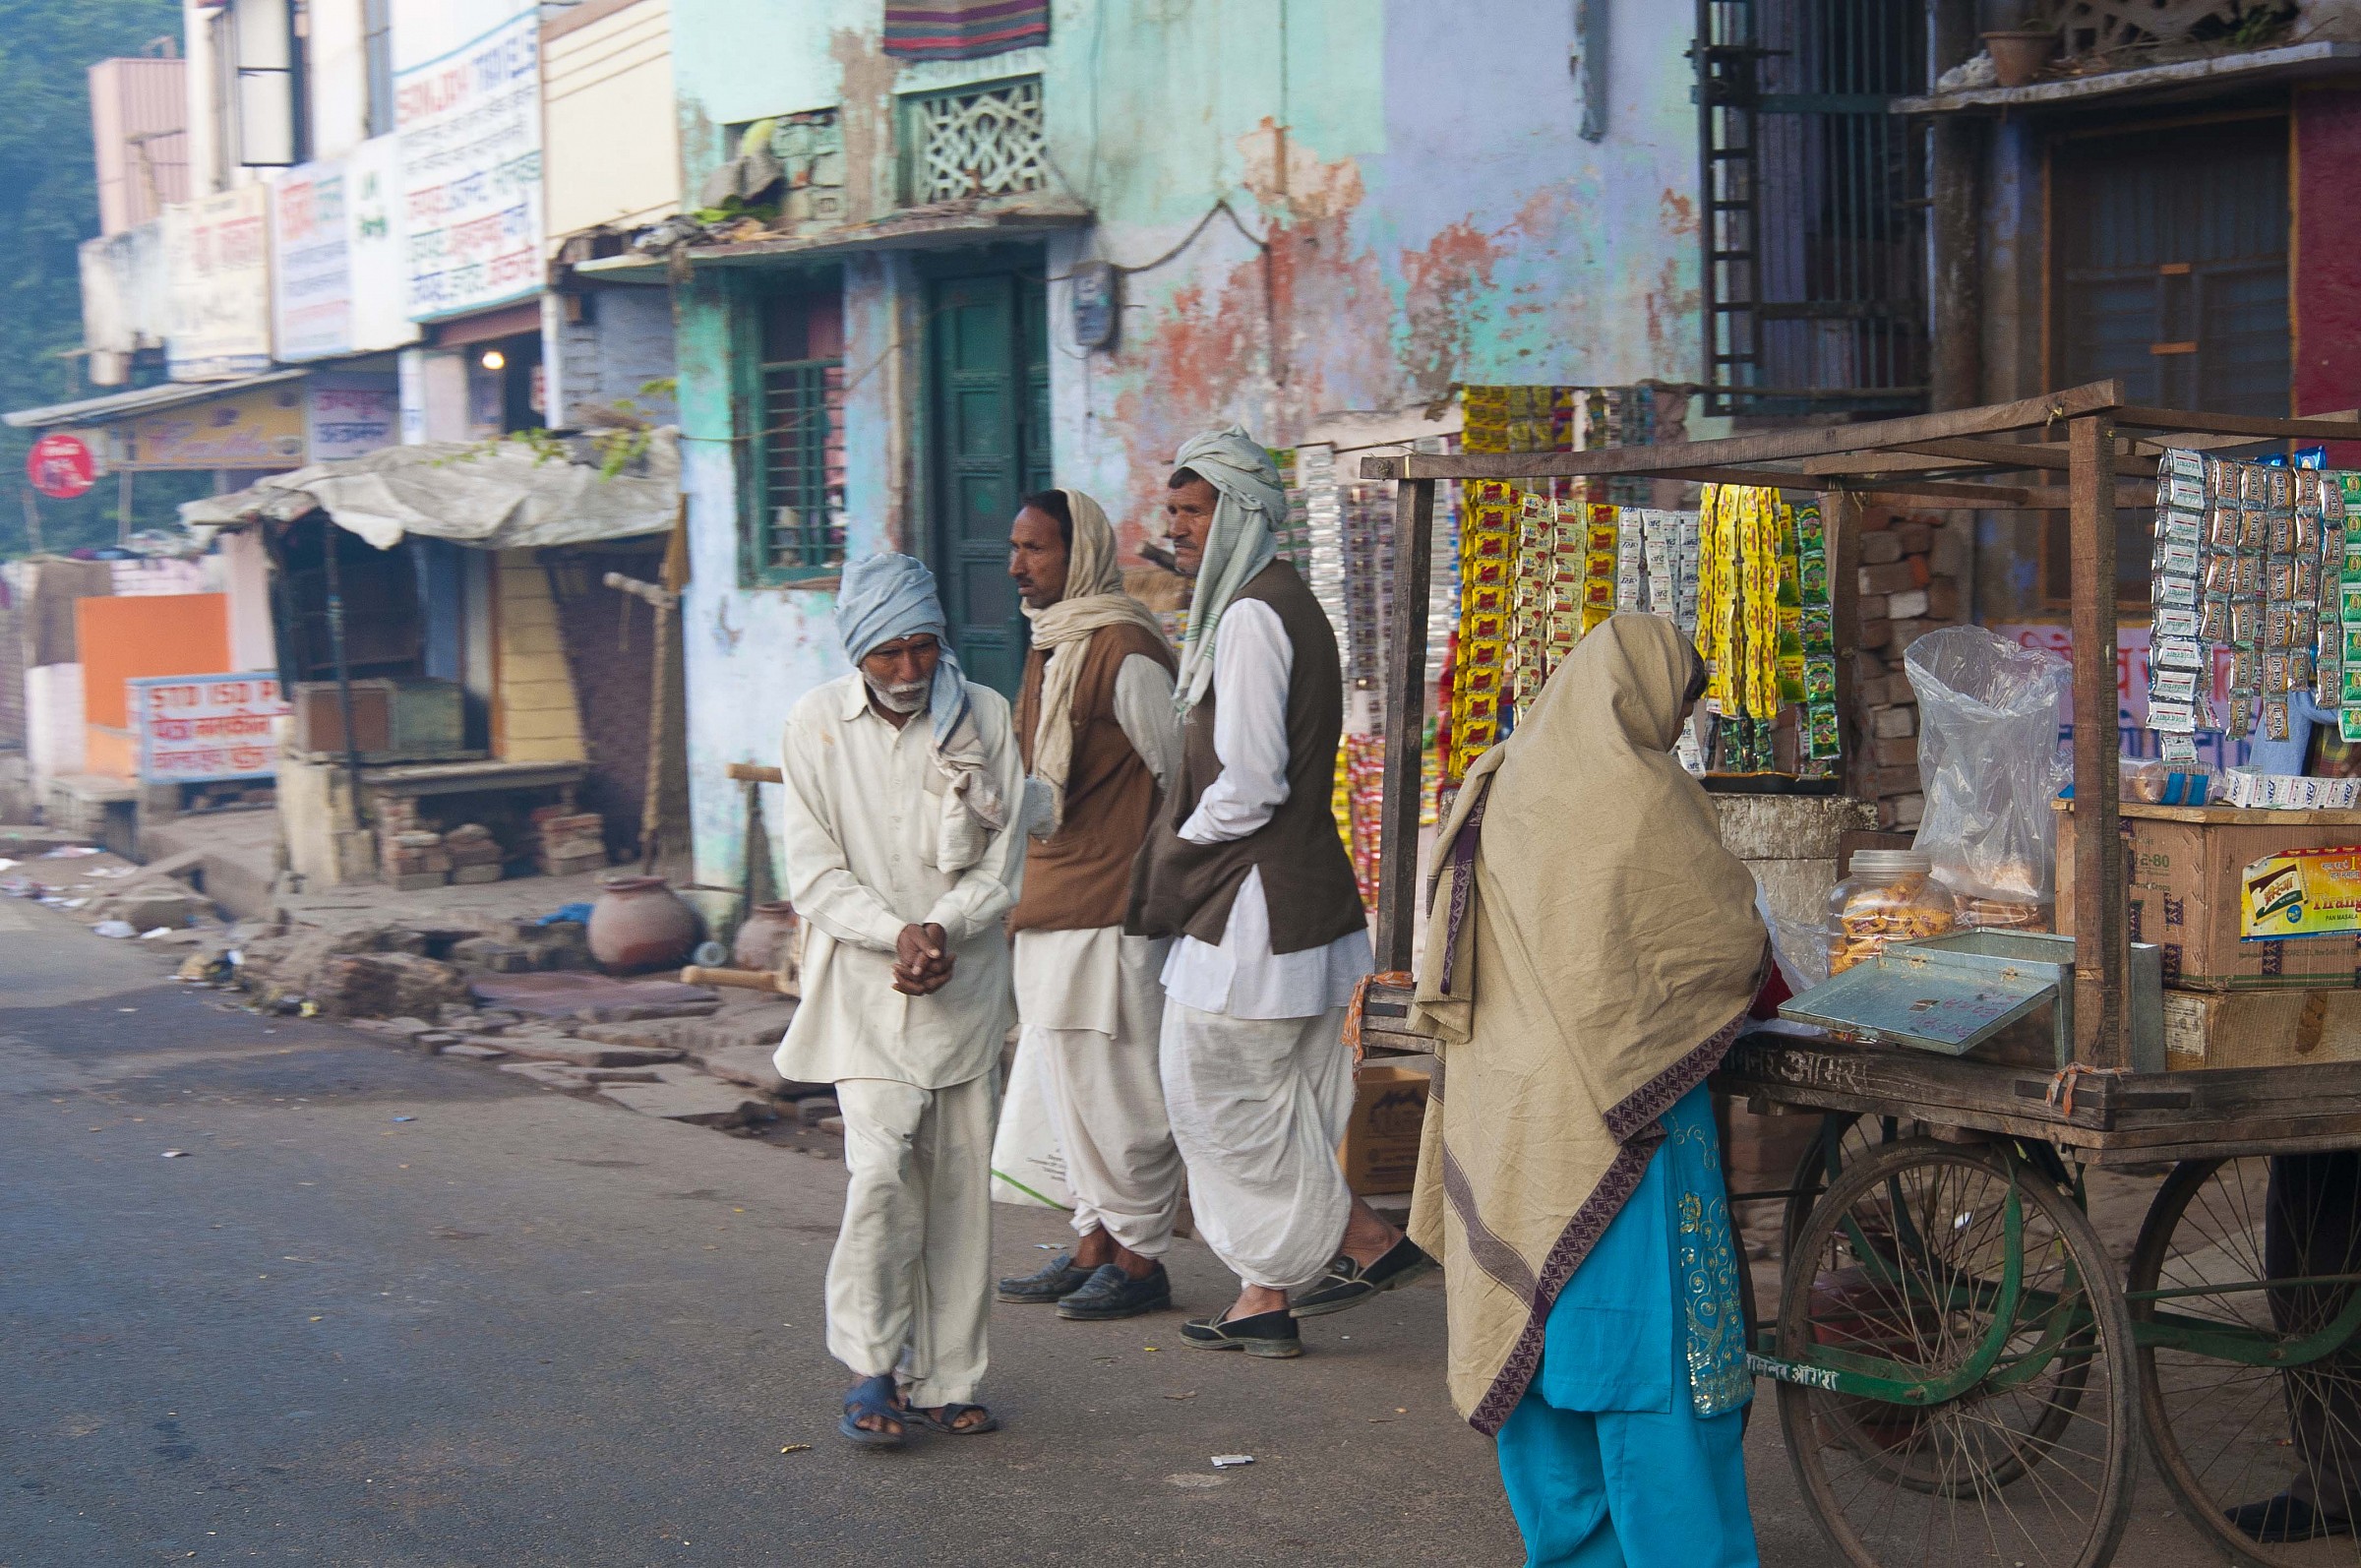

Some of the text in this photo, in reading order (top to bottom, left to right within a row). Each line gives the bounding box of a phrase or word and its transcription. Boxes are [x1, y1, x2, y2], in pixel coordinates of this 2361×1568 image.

[2276, 475, 2286, 505] राजश्री
[149, 686, 200, 708] STD
[2336, 913, 2358, 922] MASALA
